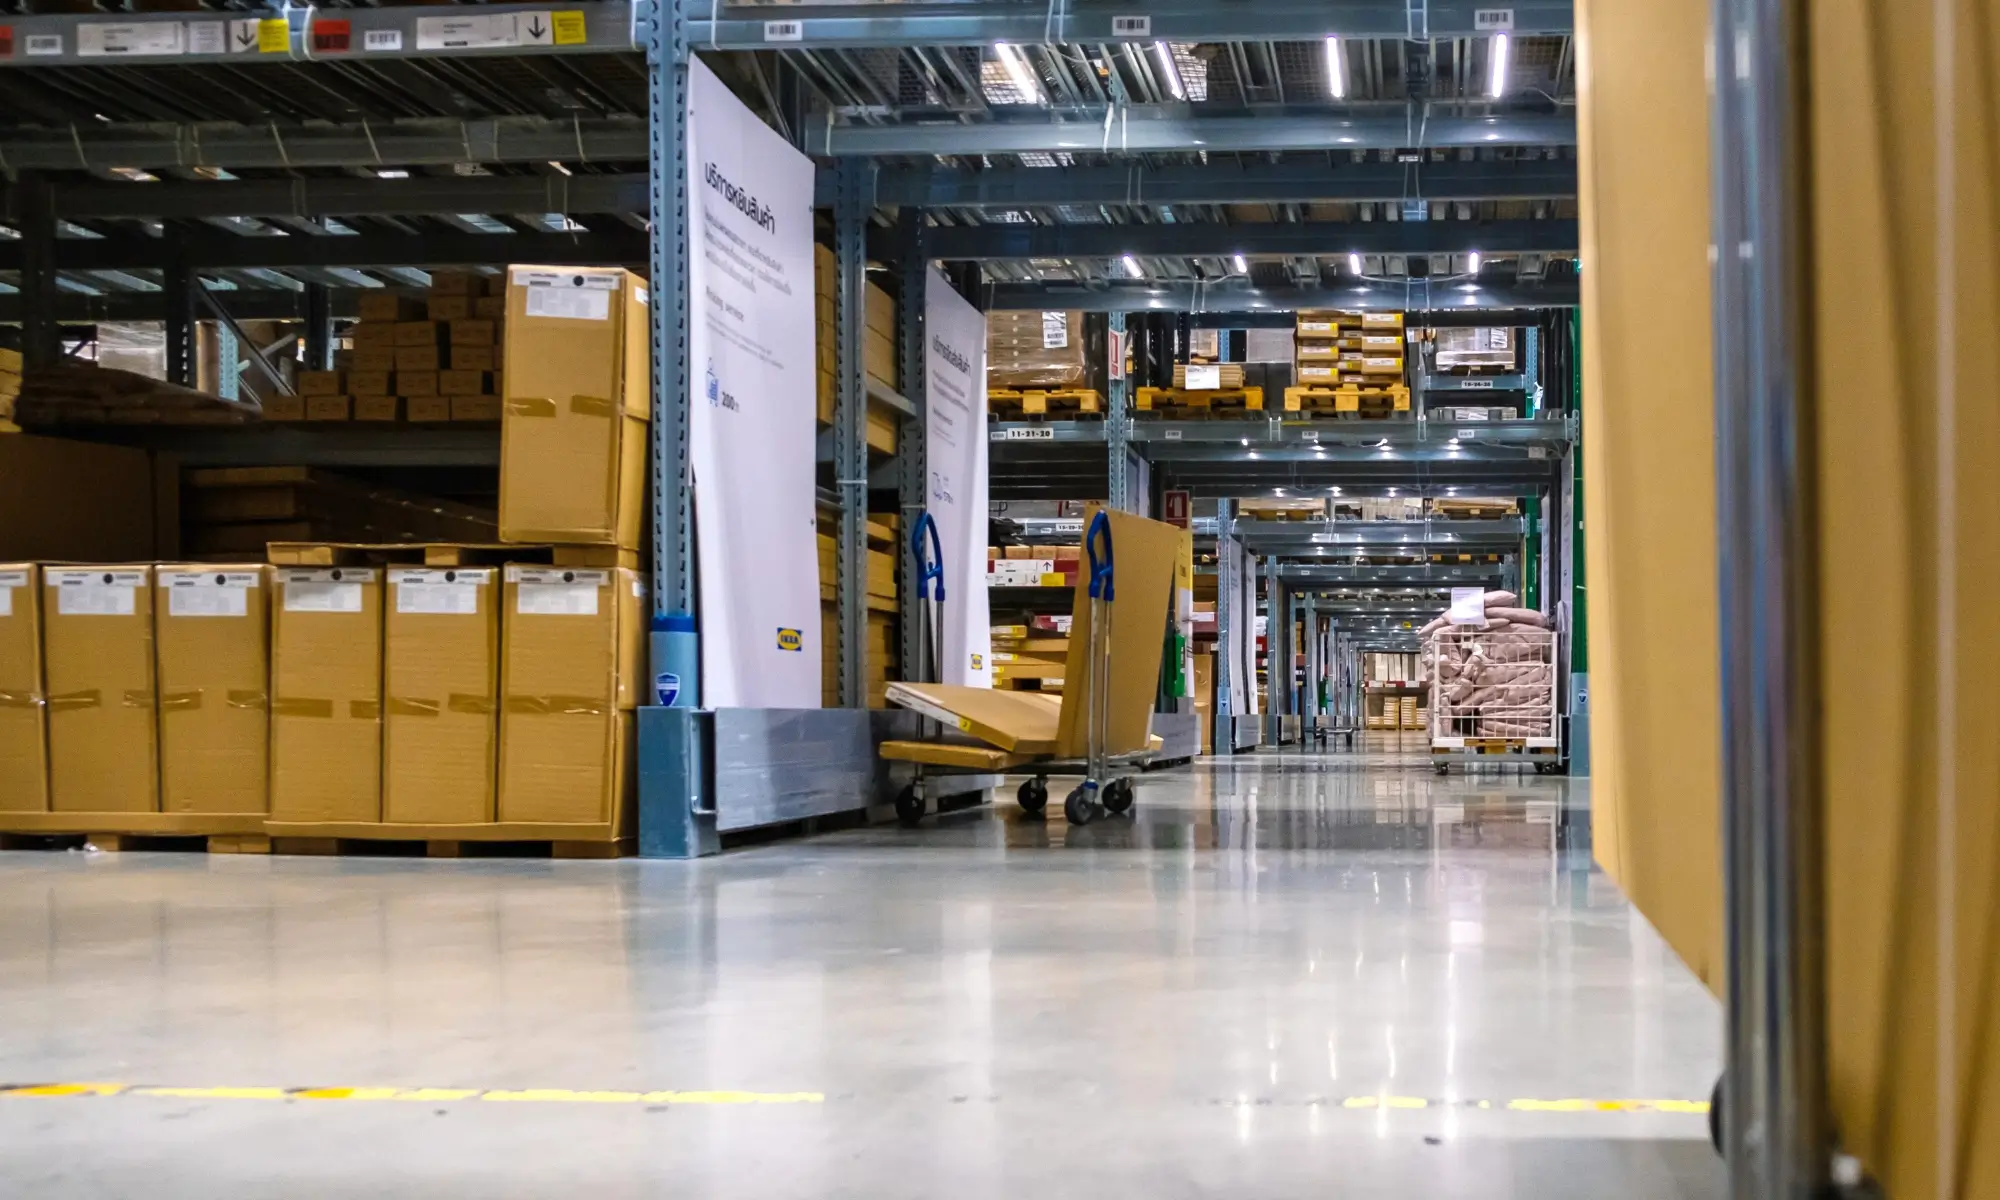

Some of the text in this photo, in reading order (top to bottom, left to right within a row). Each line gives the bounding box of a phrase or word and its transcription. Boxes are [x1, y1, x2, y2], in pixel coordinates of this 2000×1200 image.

[705, 162, 775, 235] บริการหยิบสินค้า
